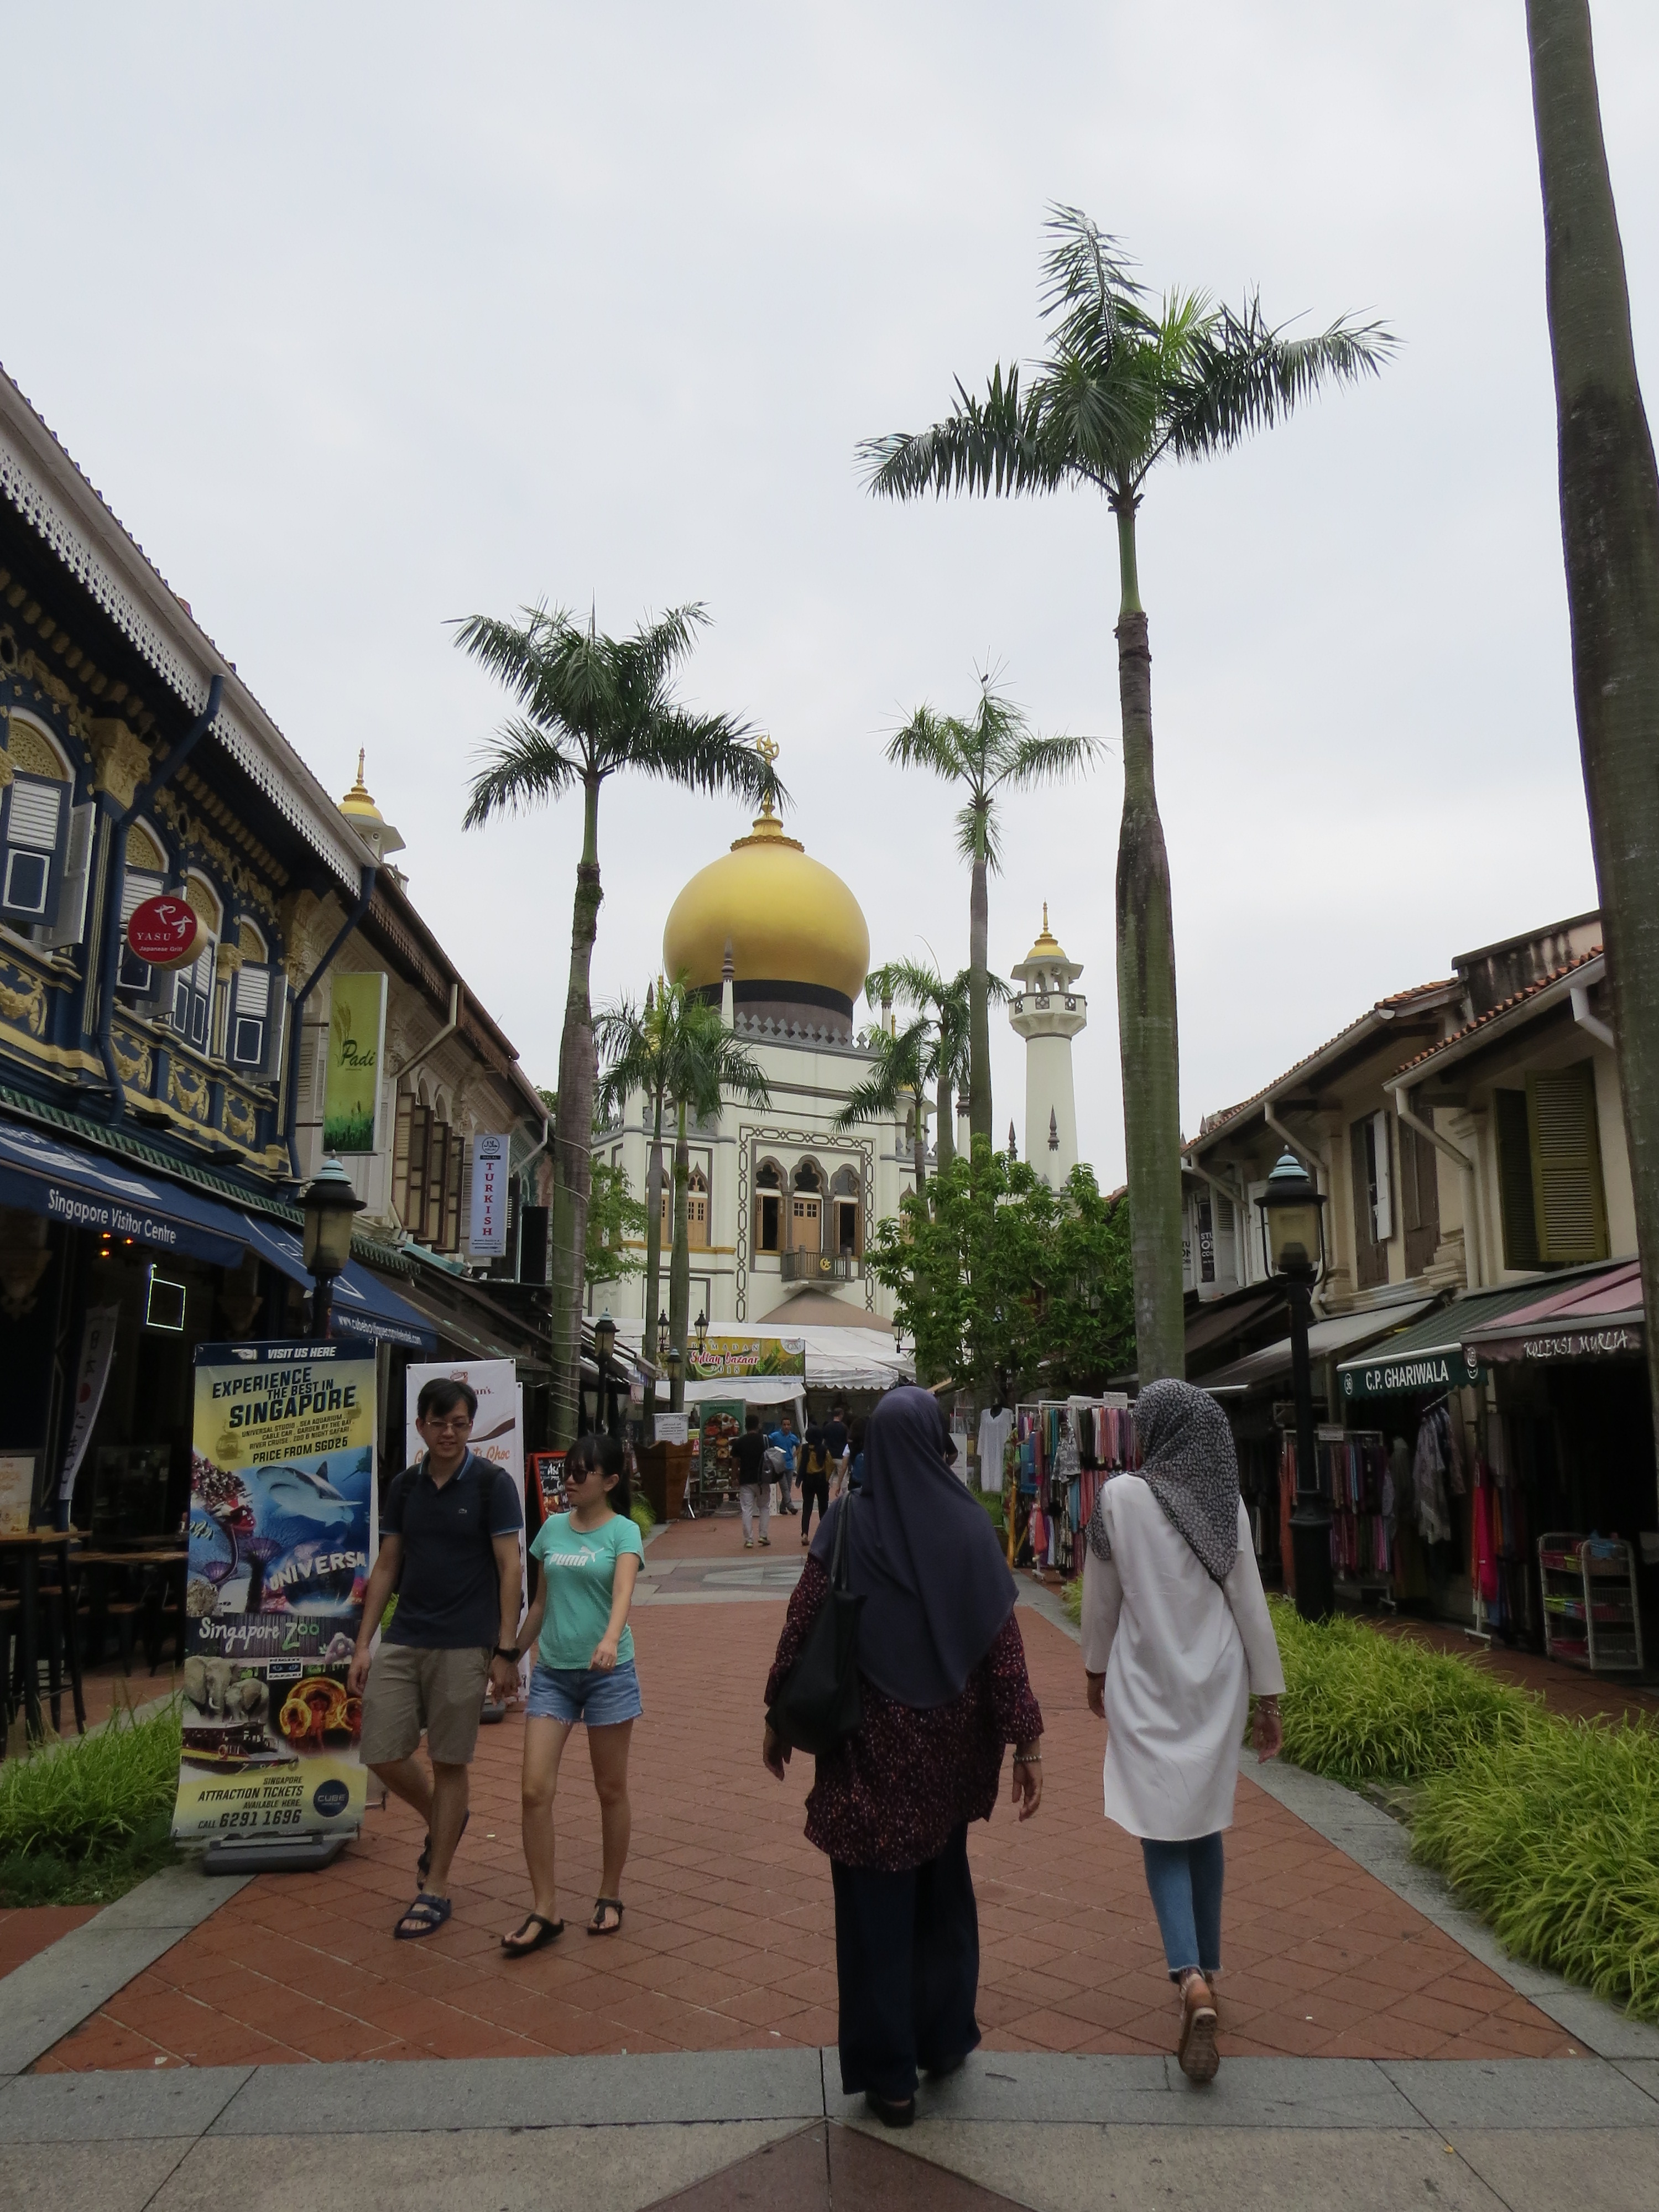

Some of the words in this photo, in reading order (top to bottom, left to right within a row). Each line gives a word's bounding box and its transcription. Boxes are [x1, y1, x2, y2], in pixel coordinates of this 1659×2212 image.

[137, 932, 171, 941] YASU
[341, 1040, 375, 1066] Padi
[482, 1162, 494, 1236] TURKISH
[48, 1188, 109, 1224] Singapore
[111, 1208, 142, 1234] Visitor
[144, 1219, 177, 1244] Centre
[267, 1348, 294, 1359] VISIT
[294, 1348, 308, 1358] US
[310, 1347, 337, 1358] HERE
[690, 1350, 723, 1365] Sultan
[724, 1352, 759, 1365] Bazaar
[1524, 1335, 1573, 1358] KOLEKSI
[711, 1365, 740, 1374] 2018
[1365, 1370, 1383, 1391] C.P.
[1384, 1359, 1449, 1389] GHARIWALA
[212, 1367, 312, 1399] EXPERIENCE
[267, 1386, 288, 1400] THE
[291, 1381, 319, 1396] BEST
[322, 1379, 333, 1391] IN
[229, 1386, 356, 1428] SINGAPORE
[242, 1427, 273, 1437] UNIVERSAL
[274, 1423, 295, 1432] STUDIO
[312, 1414, 342, 1425] AQUARIUM
[262, 1432, 279, 1441] CABLE
[298, 1425, 320, 1434] GARDEN
[249, 1441, 267, 1449] RIVER
[268, 1437, 288, 1447] CRUISE
[330, 1426, 349, 1435] SAFARI
[253, 1449, 282, 1464] PRICE
[284, 1444, 312, 1458] FROM
[315, 1436, 348, 1452] SGD25
[549, 1553, 589, 1567] PUMA
[199, 1616, 280, 1653] Singapore
[281, 1622, 321, 1651] Zoo
[263, 1776, 303, 1785] SINGAPORE
[198, 1787, 260, 1802] ATTRACTION
[263, 1785, 304, 1798] TICKETS
[243, 1801, 278, 1809] AVAILABLE
[198, 1820, 217, 1829] CALL
[220, 1811, 257, 1827] 6291
[262, 1809, 302, 1825] 1696
